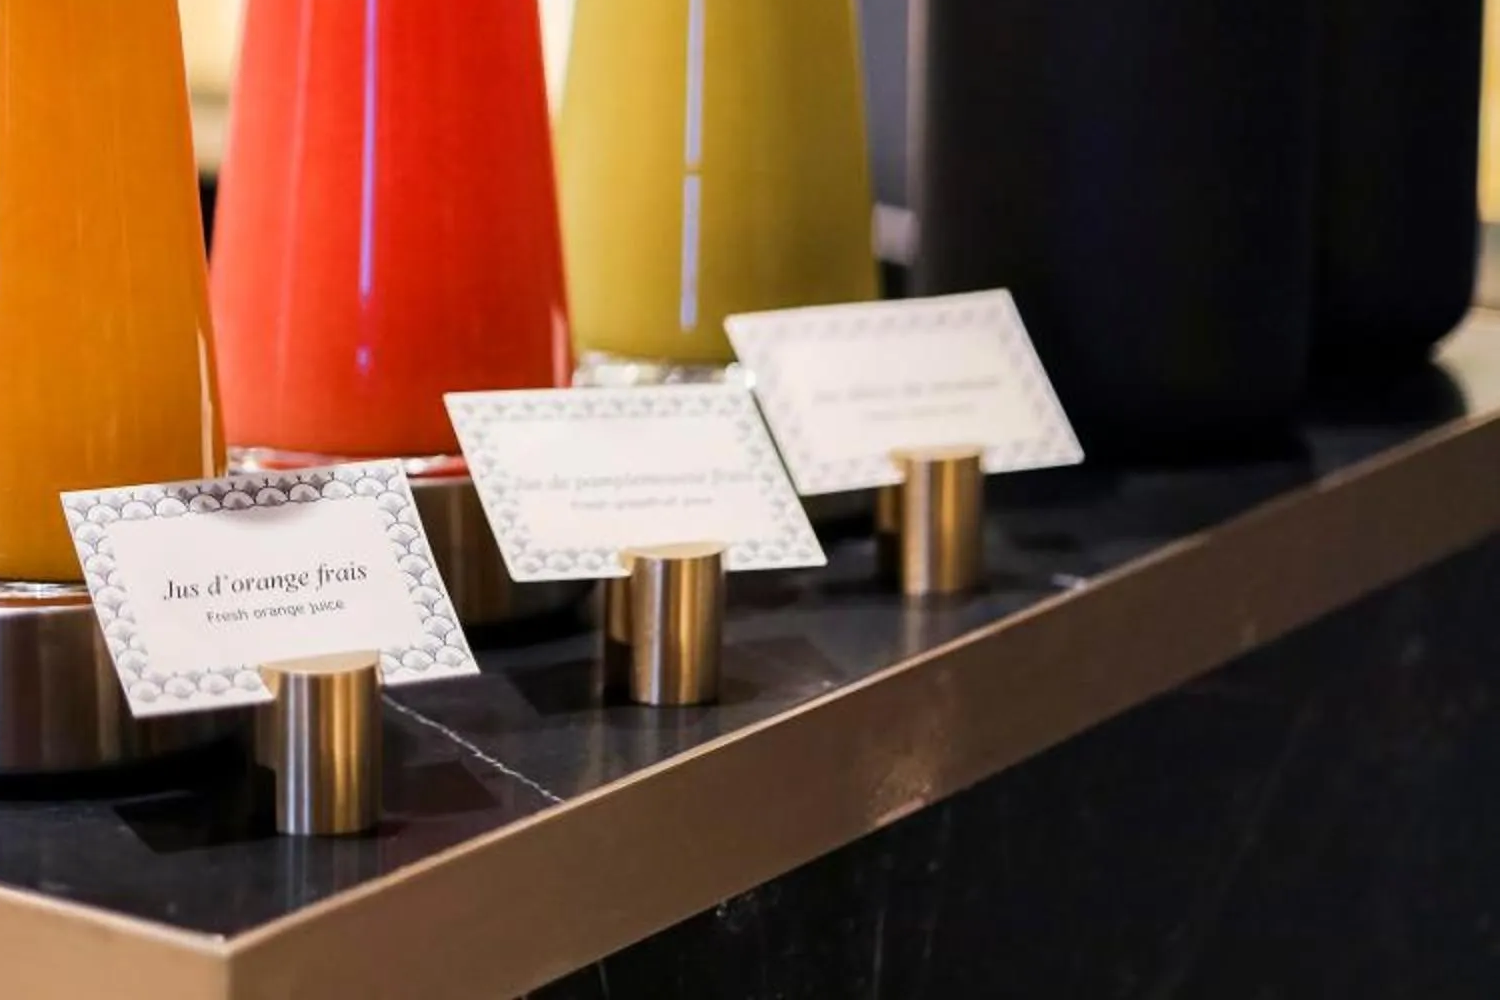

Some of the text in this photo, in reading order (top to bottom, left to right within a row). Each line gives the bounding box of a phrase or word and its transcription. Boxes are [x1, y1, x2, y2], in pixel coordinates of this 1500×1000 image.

[163, 561, 369, 601] Jus d'orange frais
[206, 597, 346, 625] Fresh orange juice
